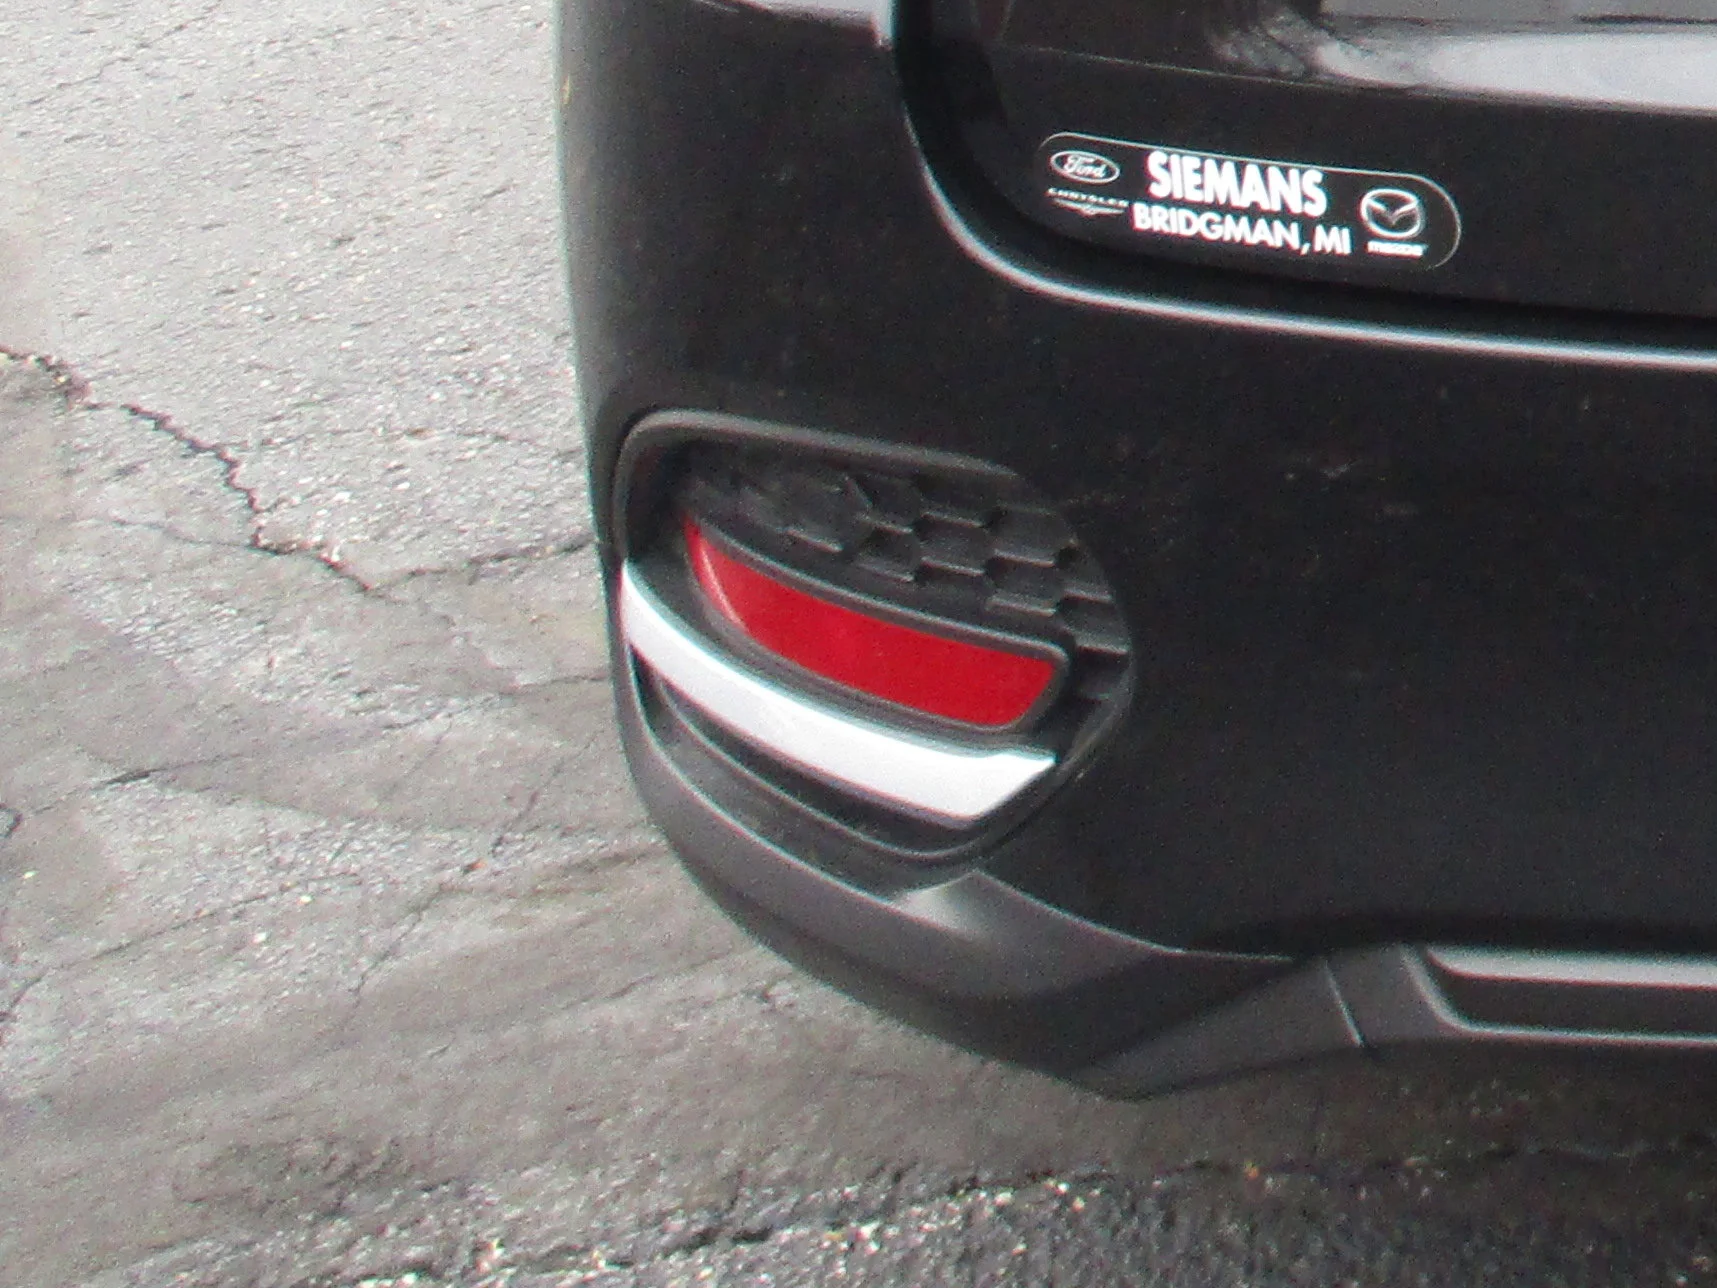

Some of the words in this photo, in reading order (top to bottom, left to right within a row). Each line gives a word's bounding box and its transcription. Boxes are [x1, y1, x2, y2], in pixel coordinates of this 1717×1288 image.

[1146, 150, 1328, 218] SIEMANS
[1132, 201, 1310, 256] BRIDGMAN,
[1312, 224, 1353, 256] MI
